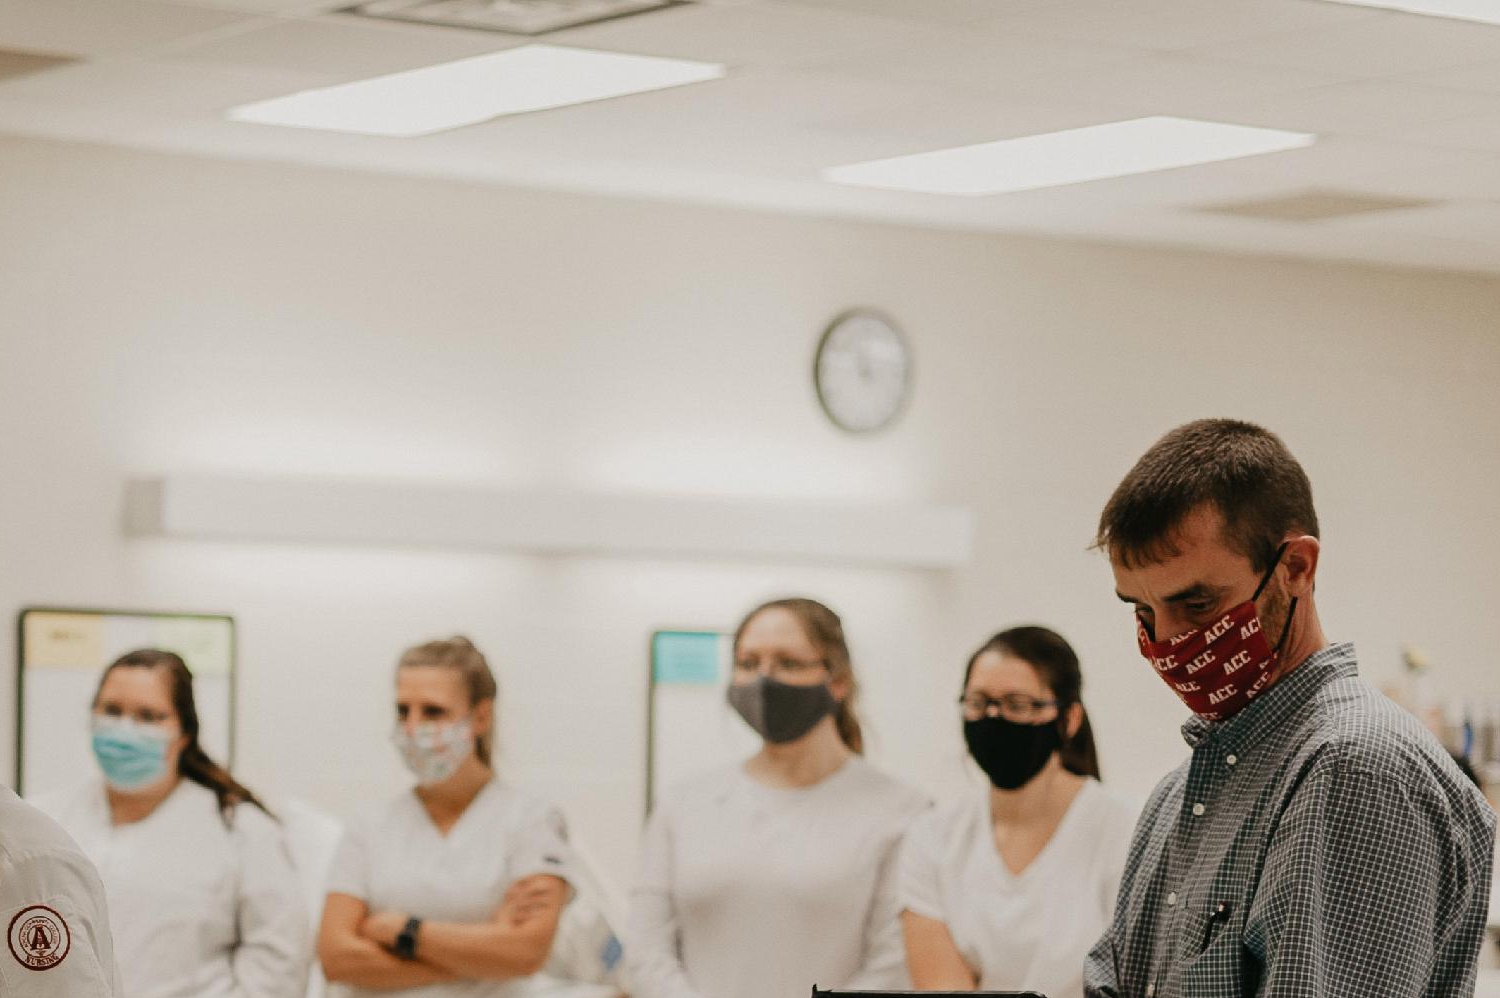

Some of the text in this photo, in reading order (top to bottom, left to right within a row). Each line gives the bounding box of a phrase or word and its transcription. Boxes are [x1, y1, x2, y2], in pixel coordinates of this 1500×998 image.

[1204, 615, 1235, 645] ACC
[1185, 650, 1216, 675] ACC
[1222, 650, 1252, 675] ACC
[1208, 683, 1238, 705] ACC
[24, 952, 59, 966] NURSING
